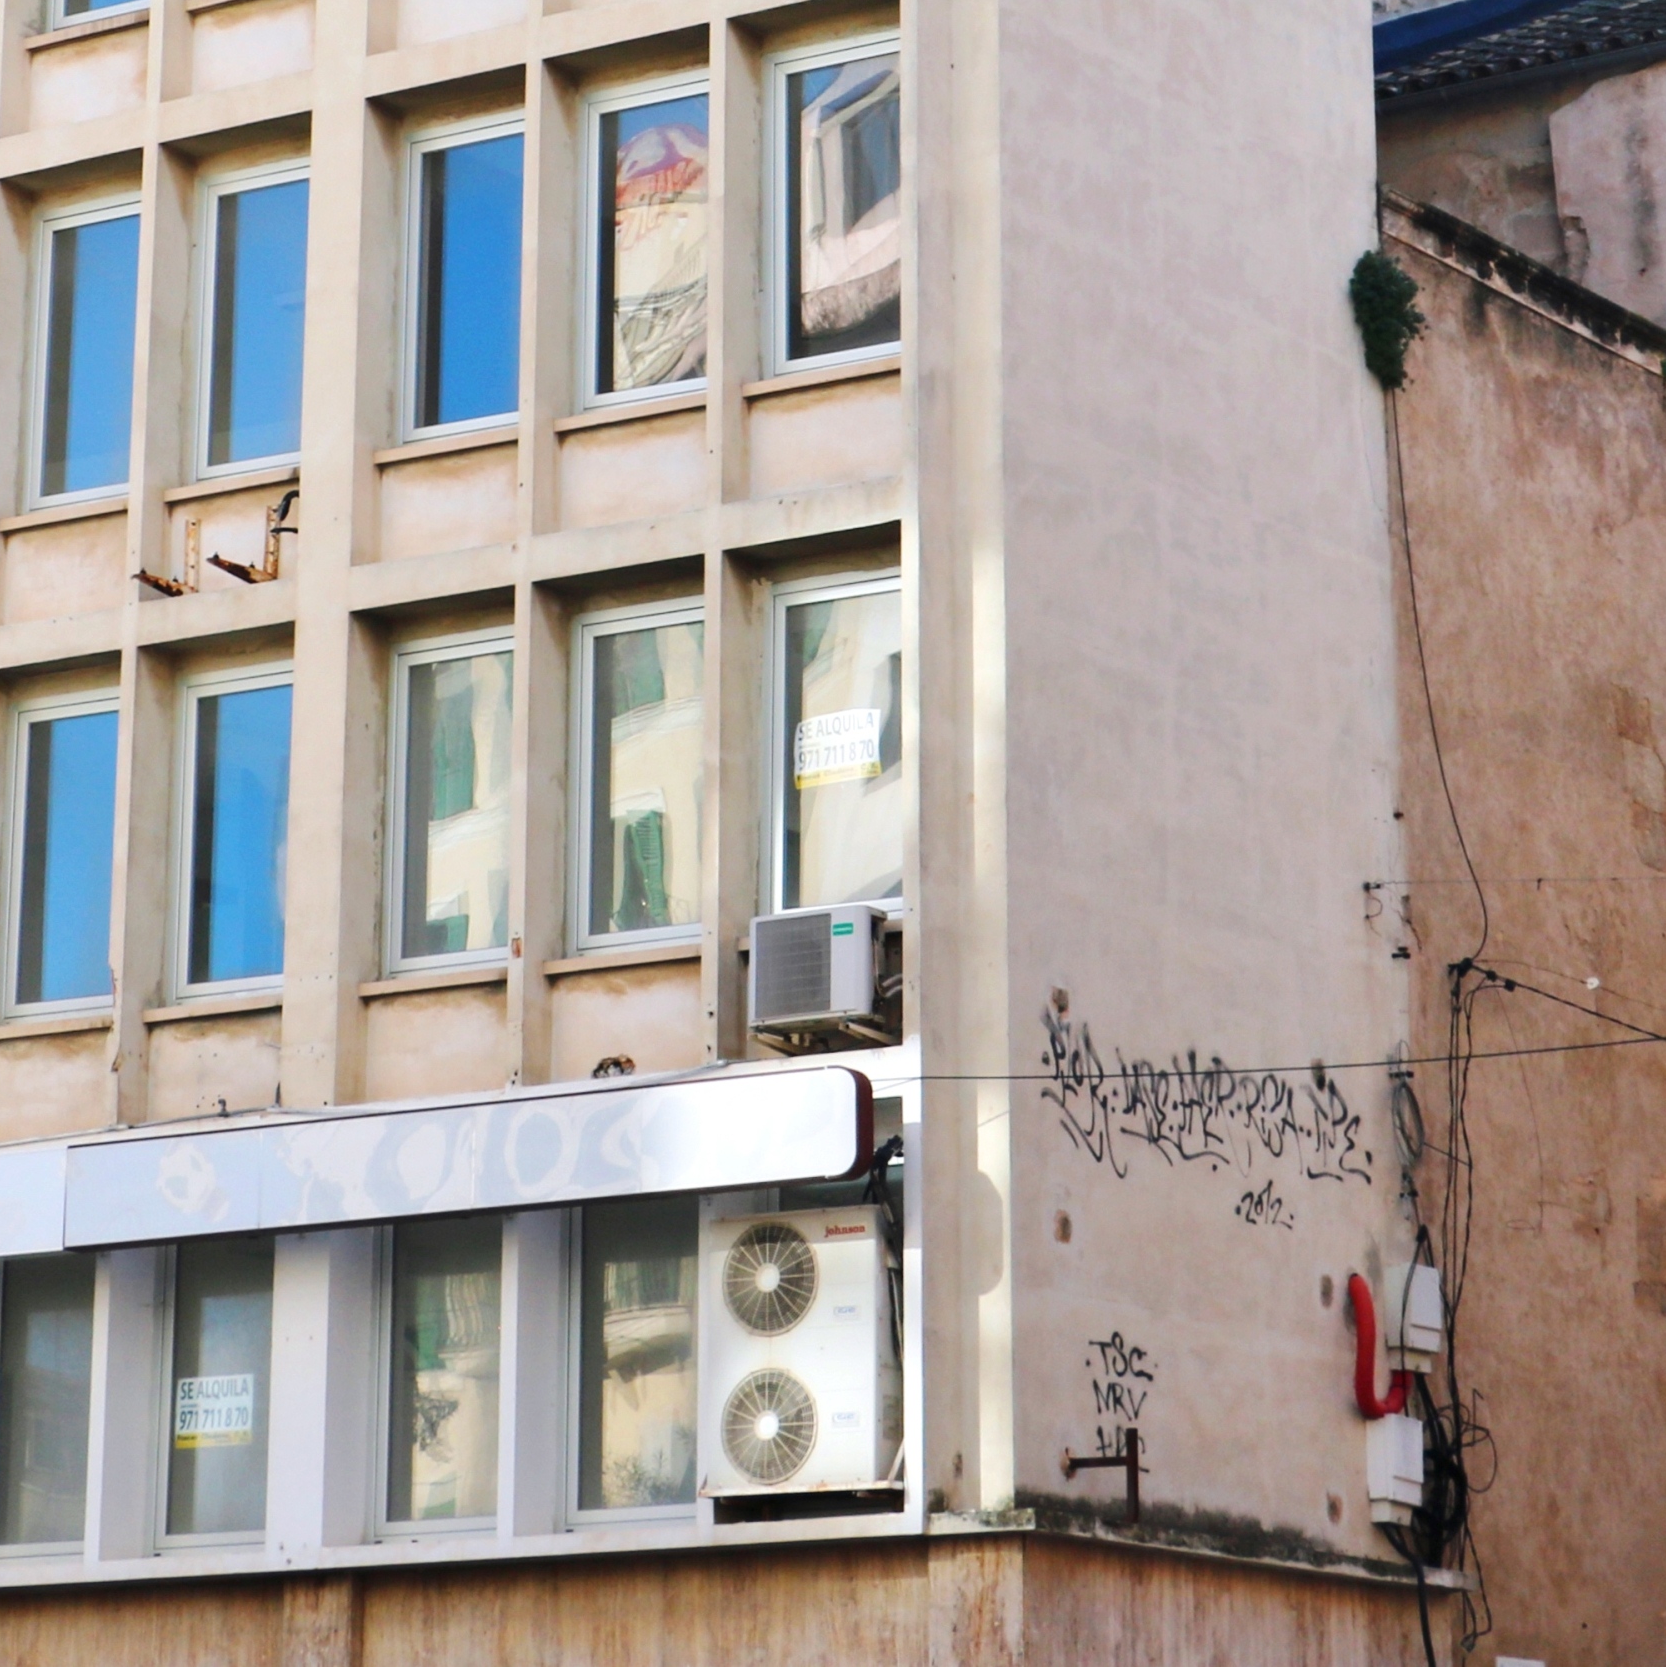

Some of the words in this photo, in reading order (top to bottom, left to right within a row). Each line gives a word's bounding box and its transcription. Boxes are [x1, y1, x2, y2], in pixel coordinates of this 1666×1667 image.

[798, 722, 812, 741] SE
[816, 712, 874, 736] ALQUILA
[799, 749, 820, 771] 971
[824, 745, 845, 766] 711
[824, 1225, 865, 1238] johnson
[180, 1382, 194, 1401] SE
[196, 1379, 249, 1399] ALQUILA
[179, 1410, 199, 1430] 971
[202, 1408, 222, 1428] 711
